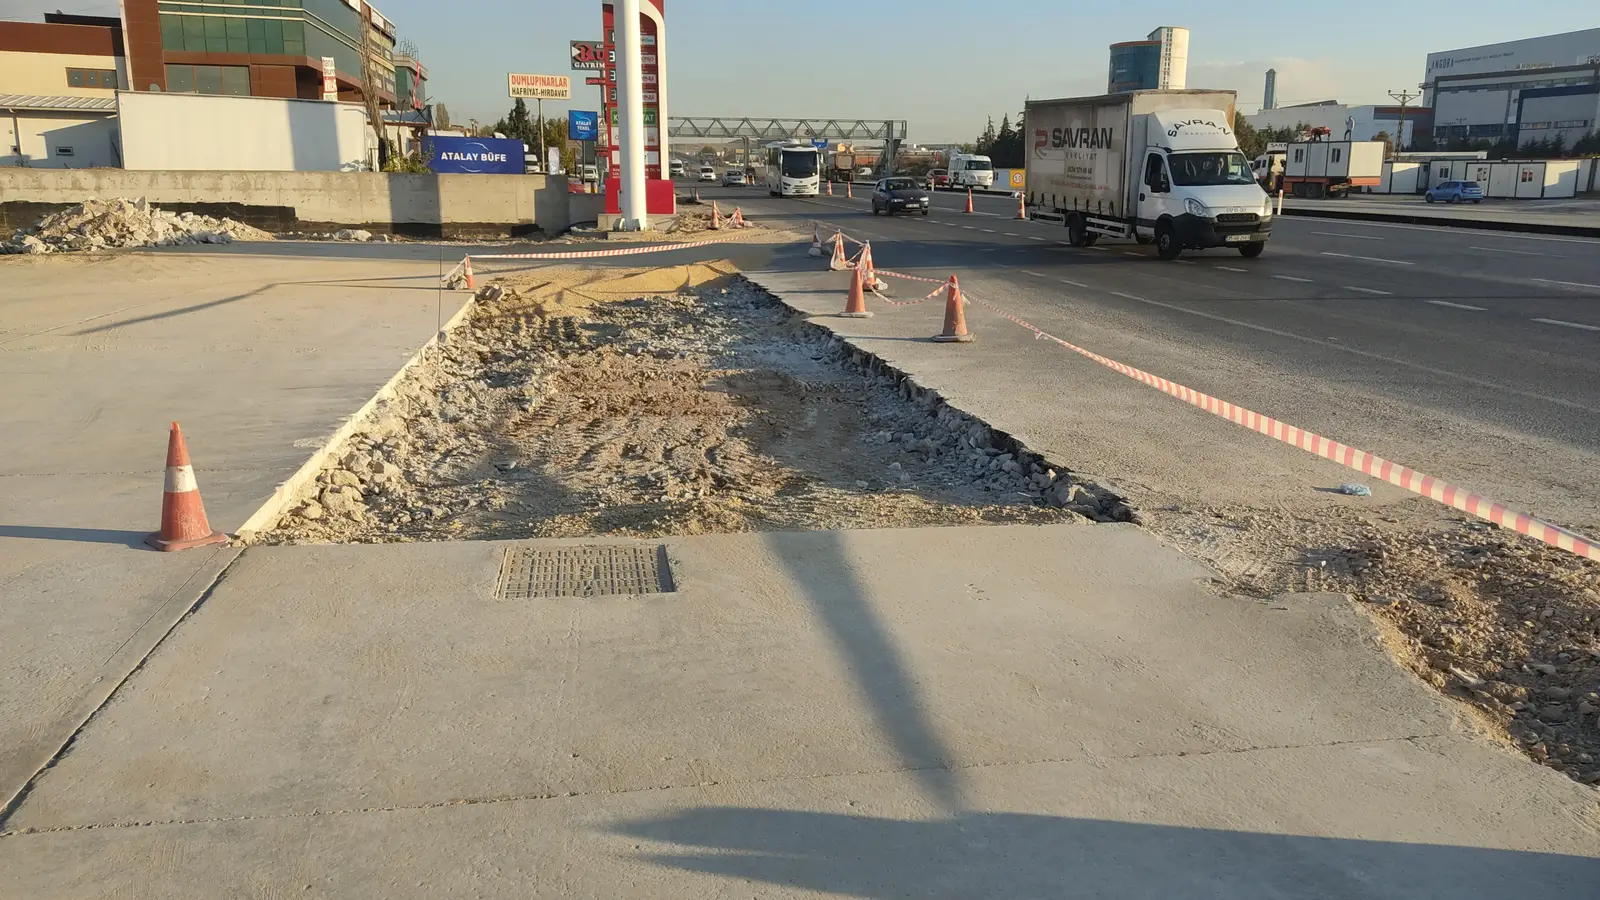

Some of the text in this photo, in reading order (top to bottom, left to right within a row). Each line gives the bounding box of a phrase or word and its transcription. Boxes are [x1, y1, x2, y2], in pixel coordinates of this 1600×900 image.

[1432, 58, 1454, 69] ANGORA
[511, 75, 568, 87] DUMLUPINARLAR
[1167, 119, 1231, 138] SAVRAN
[1051, 127, 1113, 150] SAVRAN
[441, 152, 507, 162] ATALAY BÜFE
